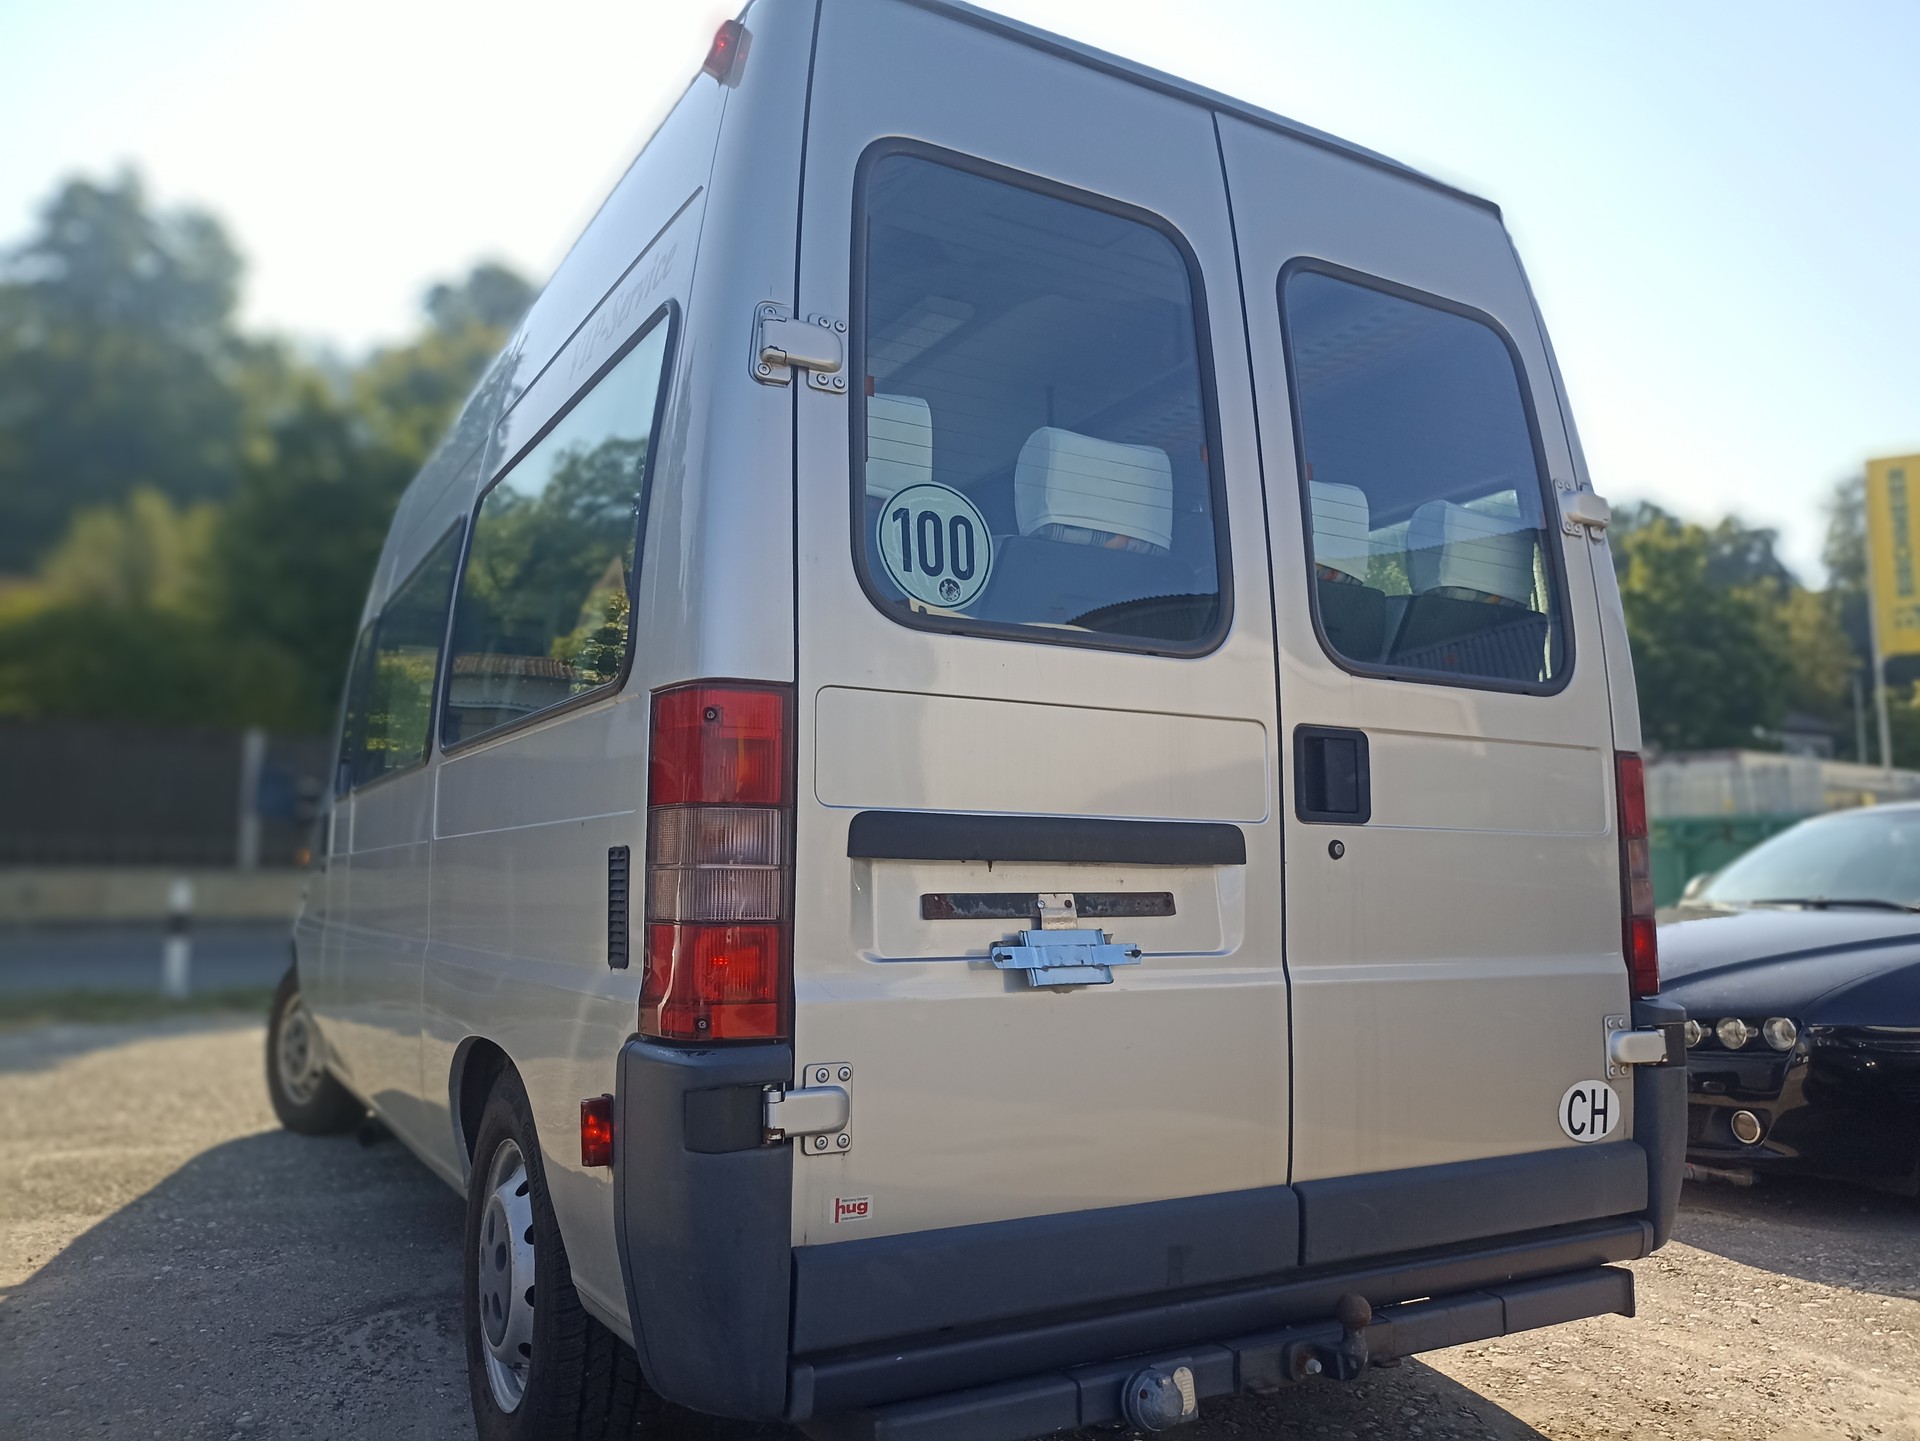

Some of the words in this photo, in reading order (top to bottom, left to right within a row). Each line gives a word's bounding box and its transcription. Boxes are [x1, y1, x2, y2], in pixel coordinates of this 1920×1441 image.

[892, 508, 975, 581] 100
[1567, 1088, 1608, 1135] CH
[835, 1197, 869, 1223] hug
